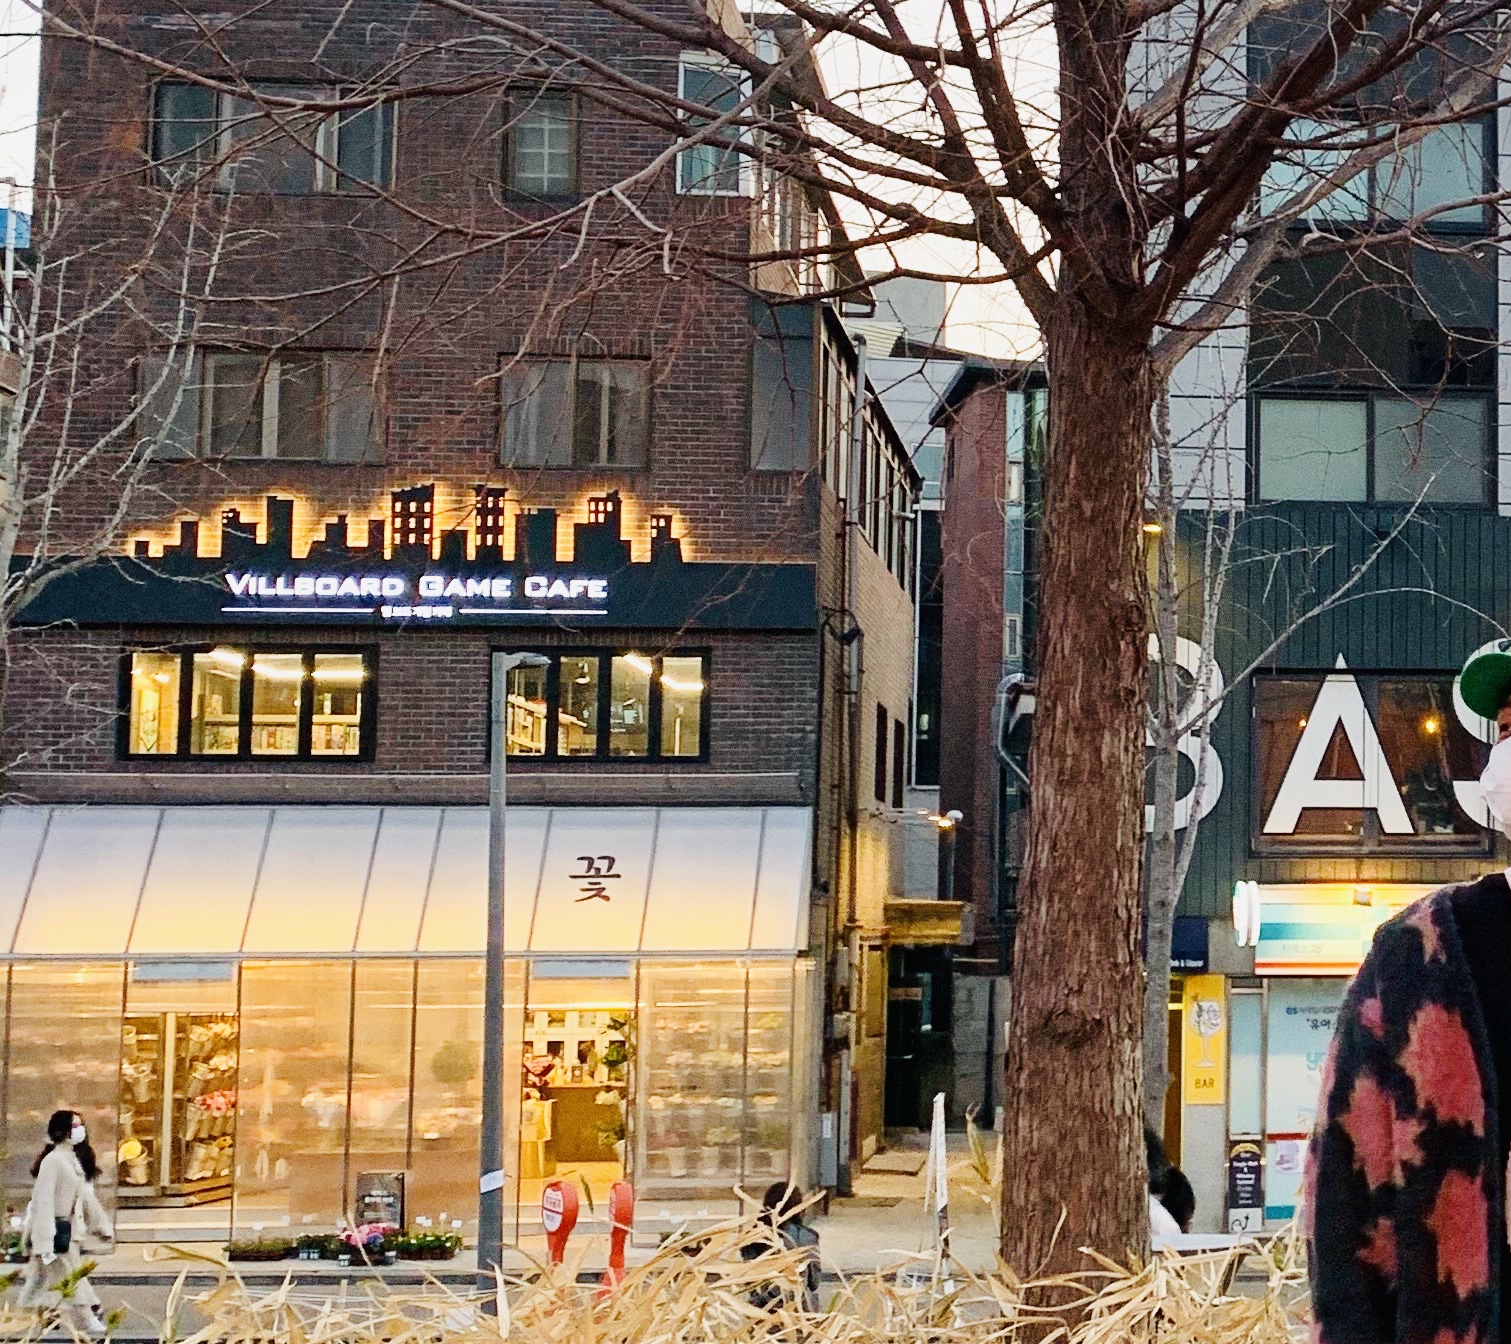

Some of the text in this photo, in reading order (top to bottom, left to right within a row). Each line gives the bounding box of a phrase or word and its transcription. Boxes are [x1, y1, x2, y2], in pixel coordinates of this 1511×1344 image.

[225, 573, 608, 598] VILLBOARD GAME CAFE
[569, 856, 621, 902] 꽃
[1194, 1078, 1215, 1089] BAR
